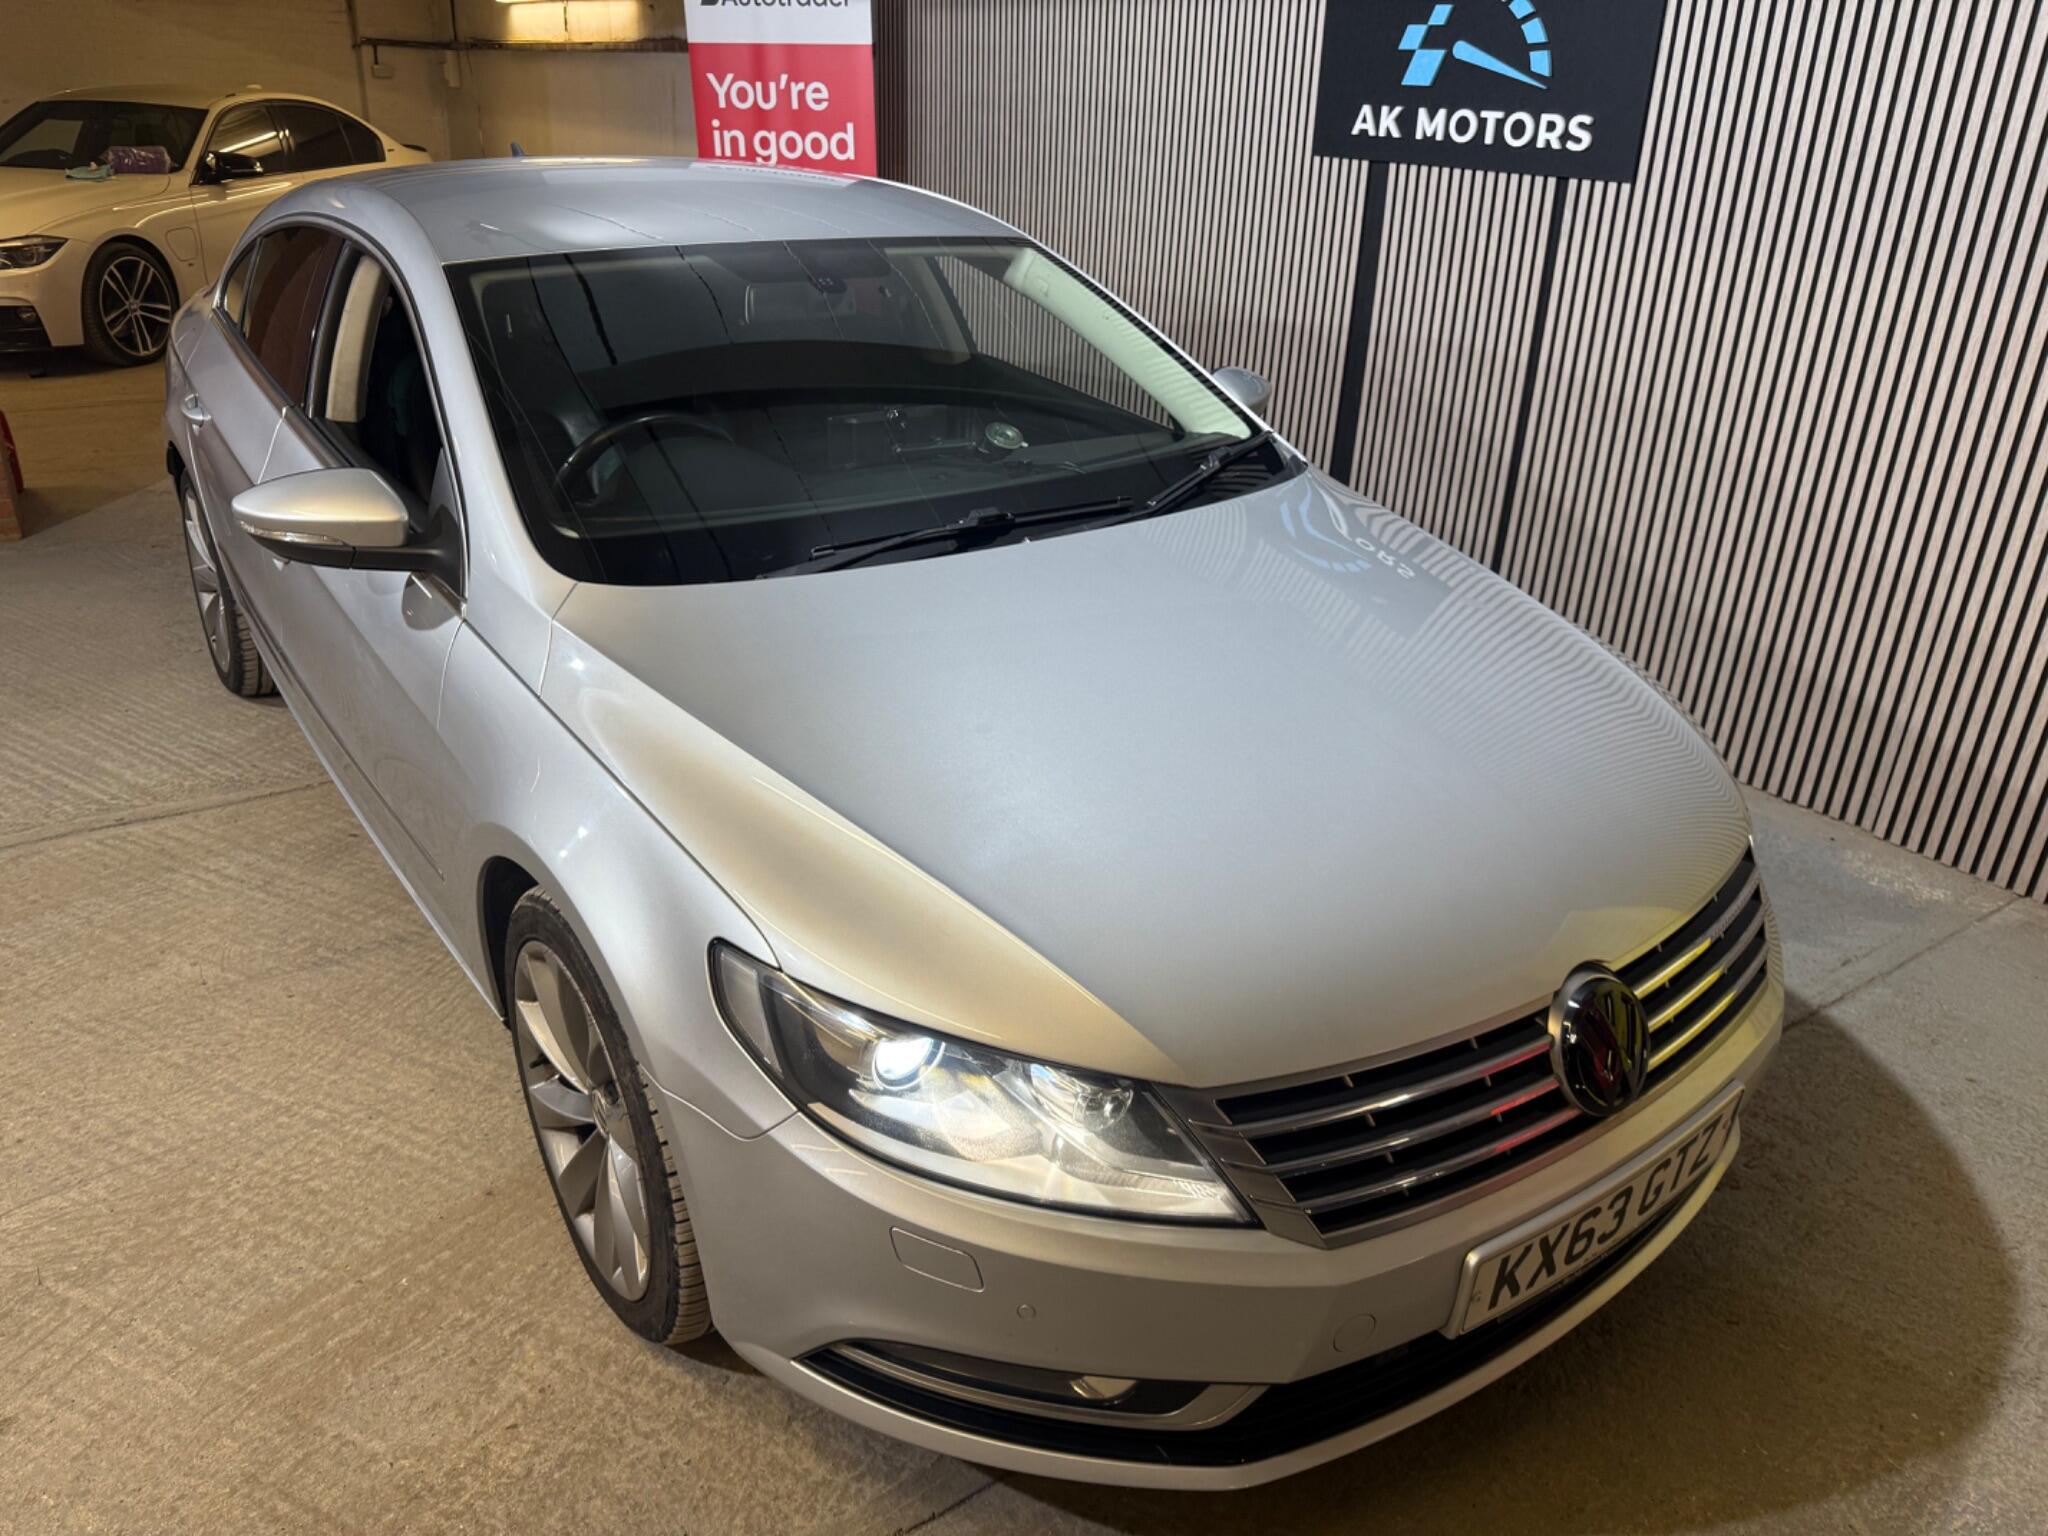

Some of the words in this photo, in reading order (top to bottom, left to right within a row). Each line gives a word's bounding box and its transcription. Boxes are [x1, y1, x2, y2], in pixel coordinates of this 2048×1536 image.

[706, 73, 829, 111] You're
[711, 119, 746, 157] in
[753, 122, 855, 166] good
[1351, 104, 1404, 137] AK
[1415, 107, 1594, 151] MOTORS
[1488, 1184, 1633, 1311] KX63
[1637, 1117, 1721, 1216] GTZ
